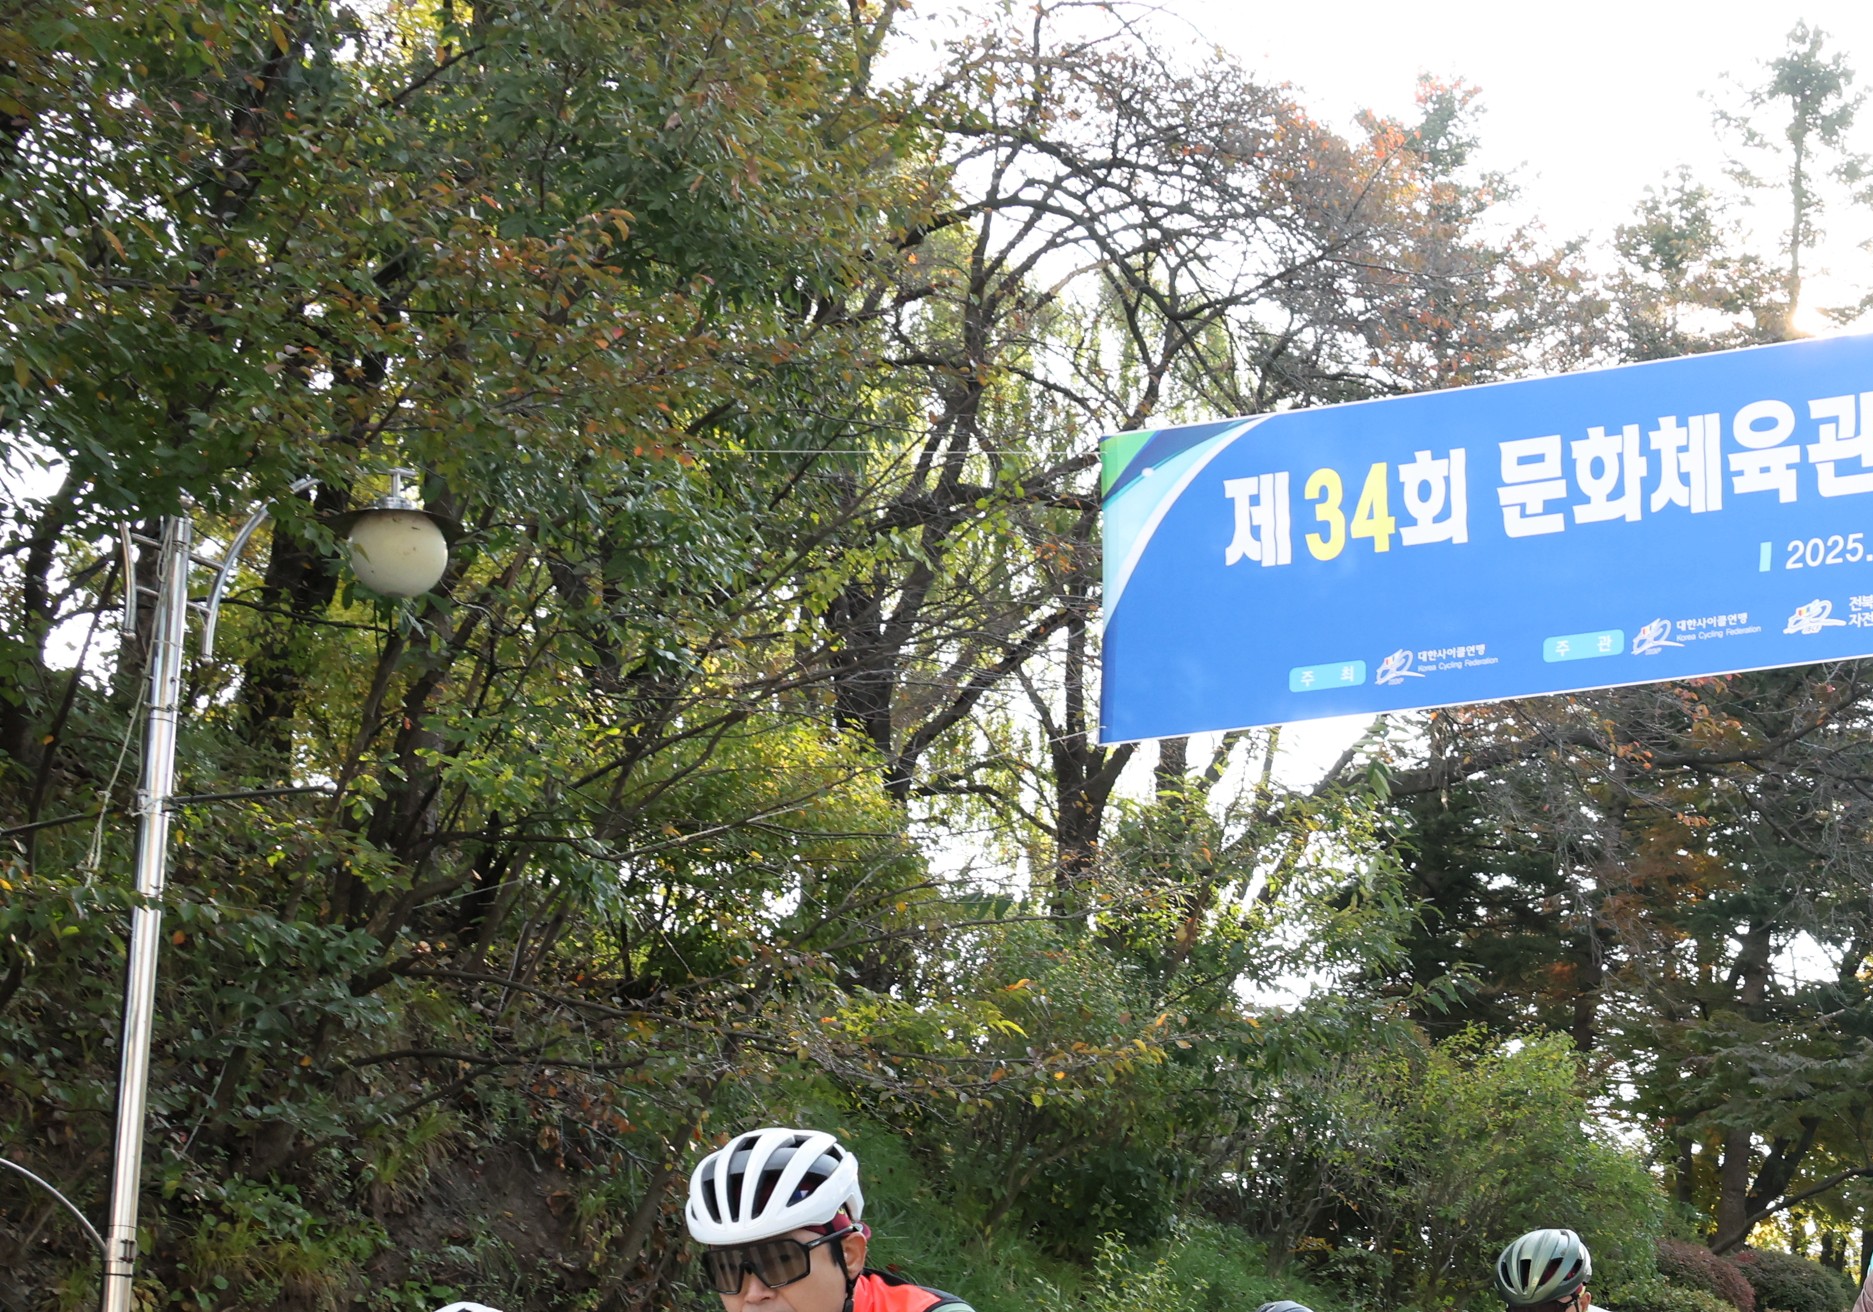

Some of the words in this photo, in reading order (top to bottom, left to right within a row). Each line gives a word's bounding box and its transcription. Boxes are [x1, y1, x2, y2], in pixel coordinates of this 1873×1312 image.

[1223, 448, 1469, 568] 제34회
[1785, 536, 1873, 570] 2025.
[1676, 612, 1748, 631] 대한사이클연맹
[1676, 633, 1697, 642] Korea
[1698, 629, 1724, 640] Cycling
[1725, 625, 1762, 637] Federation
[1417, 643, 1486, 662] 대한사이클연맹
[1417, 663, 1437, 673] Korea
[1438, 660, 1463, 671] Cycling
[1464, 655, 1499, 668] Federation
